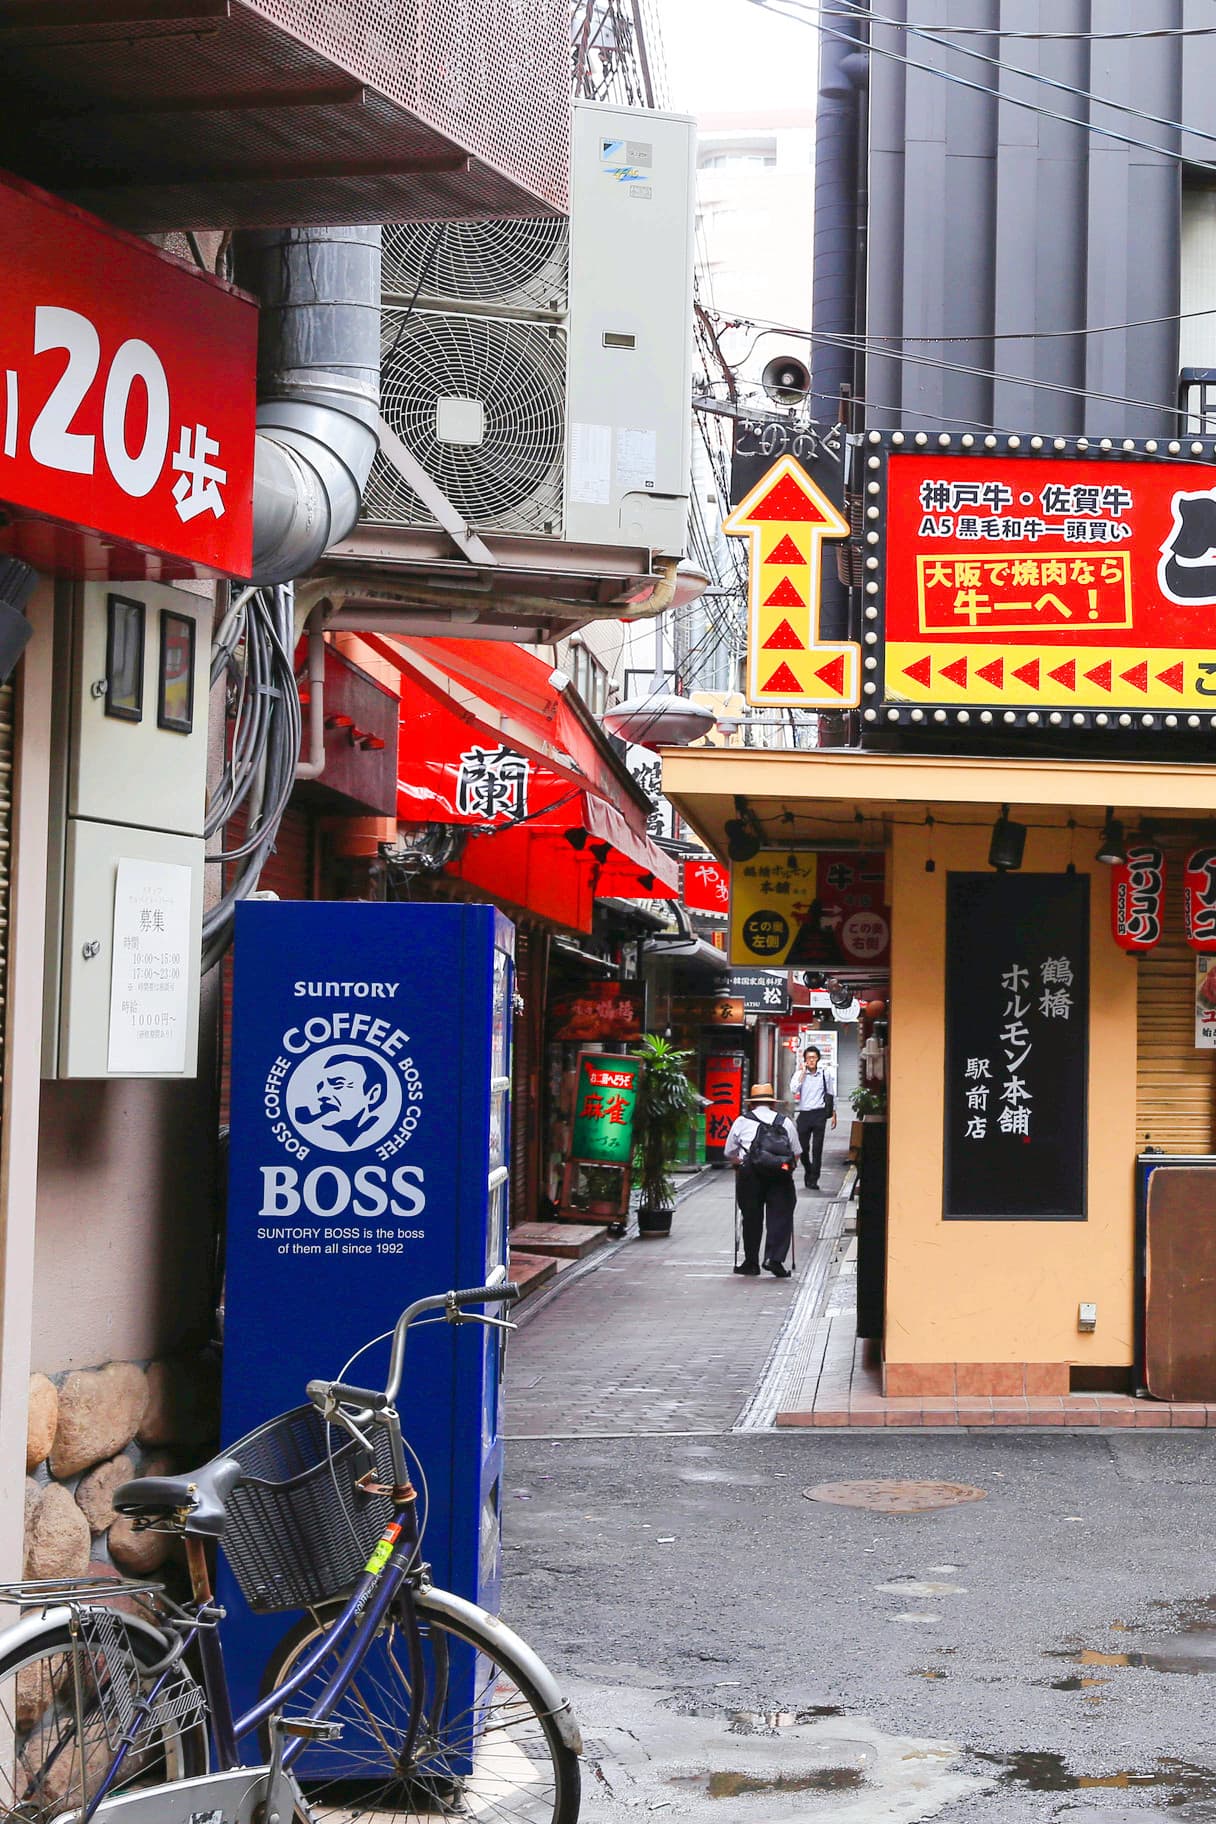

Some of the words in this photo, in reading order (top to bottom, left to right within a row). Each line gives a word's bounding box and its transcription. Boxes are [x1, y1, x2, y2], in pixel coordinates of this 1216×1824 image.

[4, 306, 227, 524] 20歩
[921, 481, 1131, 515] 神戸牛・佐賀牛
[925, 558, 1124, 588] 大阪で焼肉なら
[457, 744, 530, 819] 蘭
[139, 908, 166, 932] 募集
[1128, 848, 1164, 943] コリコリ
[1039, 956, 1075, 1020] 鶴橋
[282, 1012, 411, 1058] COFFEE
[997, 963, 1034, 1137] ホルモン本舗
[264, 1055, 292, 1119] COFFEE
[398, 1056, 424, 1101] BOSS
[964, 1057, 994, 1140] 駅前店
[375, 1105, 422, 1161] COFFEE
[579, 1092, 631, 1126] 麻雀
[709, 1082, 735, 1140] 三松
[271, 1121, 311, 1161] BOSS
[257, 1165, 426, 1217] BOSS
[257, 1228, 321, 1239] SUNTORY
[324, 1228, 360, 1239] BOSS
[363, 1228, 373, 1239] is
[376, 1228, 394, 1239] the
[397, 1228, 425, 1239] boss
[277, 1243, 290, 1254] of
[292, 1243, 321, 1254] them
[324, 1243, 339, 1254] all
[341, 1243, 372, 1254] since
[376, 1243, 404, 1254] 1992
